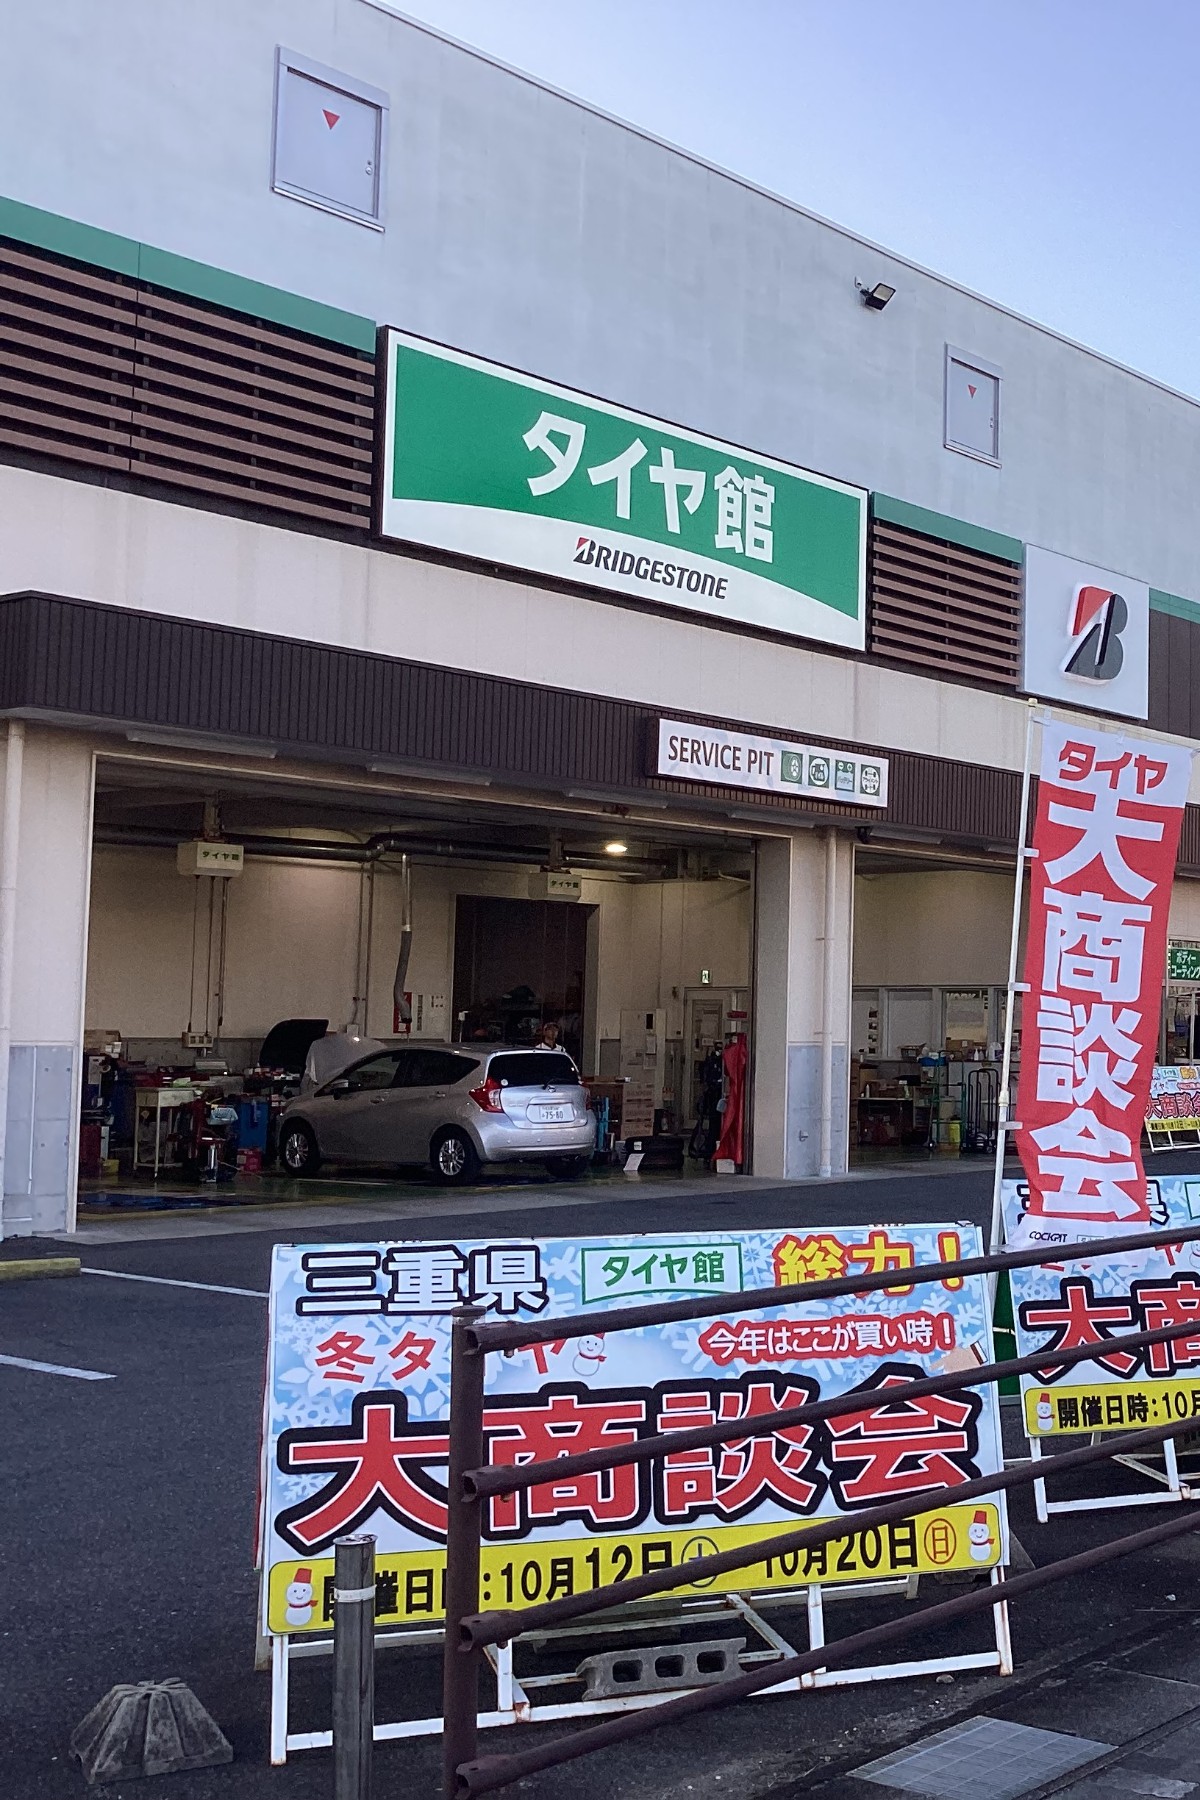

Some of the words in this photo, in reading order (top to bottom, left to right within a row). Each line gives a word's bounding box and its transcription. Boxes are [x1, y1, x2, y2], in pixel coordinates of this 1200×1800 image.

[522, 411, 775, 564] タイヤ館
[573, 536, 729, 599] BRIDGESTONE
[668, 735, 742, 772] SERVICE
[747, 748, 775, 776] PIT
[1058, 740, 1168, 795] タイヤ
[1029, 797, 1165, 1220] 大商談会
[1029, 1231, 1068, 1243] COCKPIT
[296, 1244, 550, 1316] 三重県
[602, 1250, 725, 1287] タイヤ館
[315, 1331, 568, 1384] 冬タヤ
[707, 1316, 953, 1359] 今年はここが買い時！
[275, 1361, 984, 1557] 大商談会
